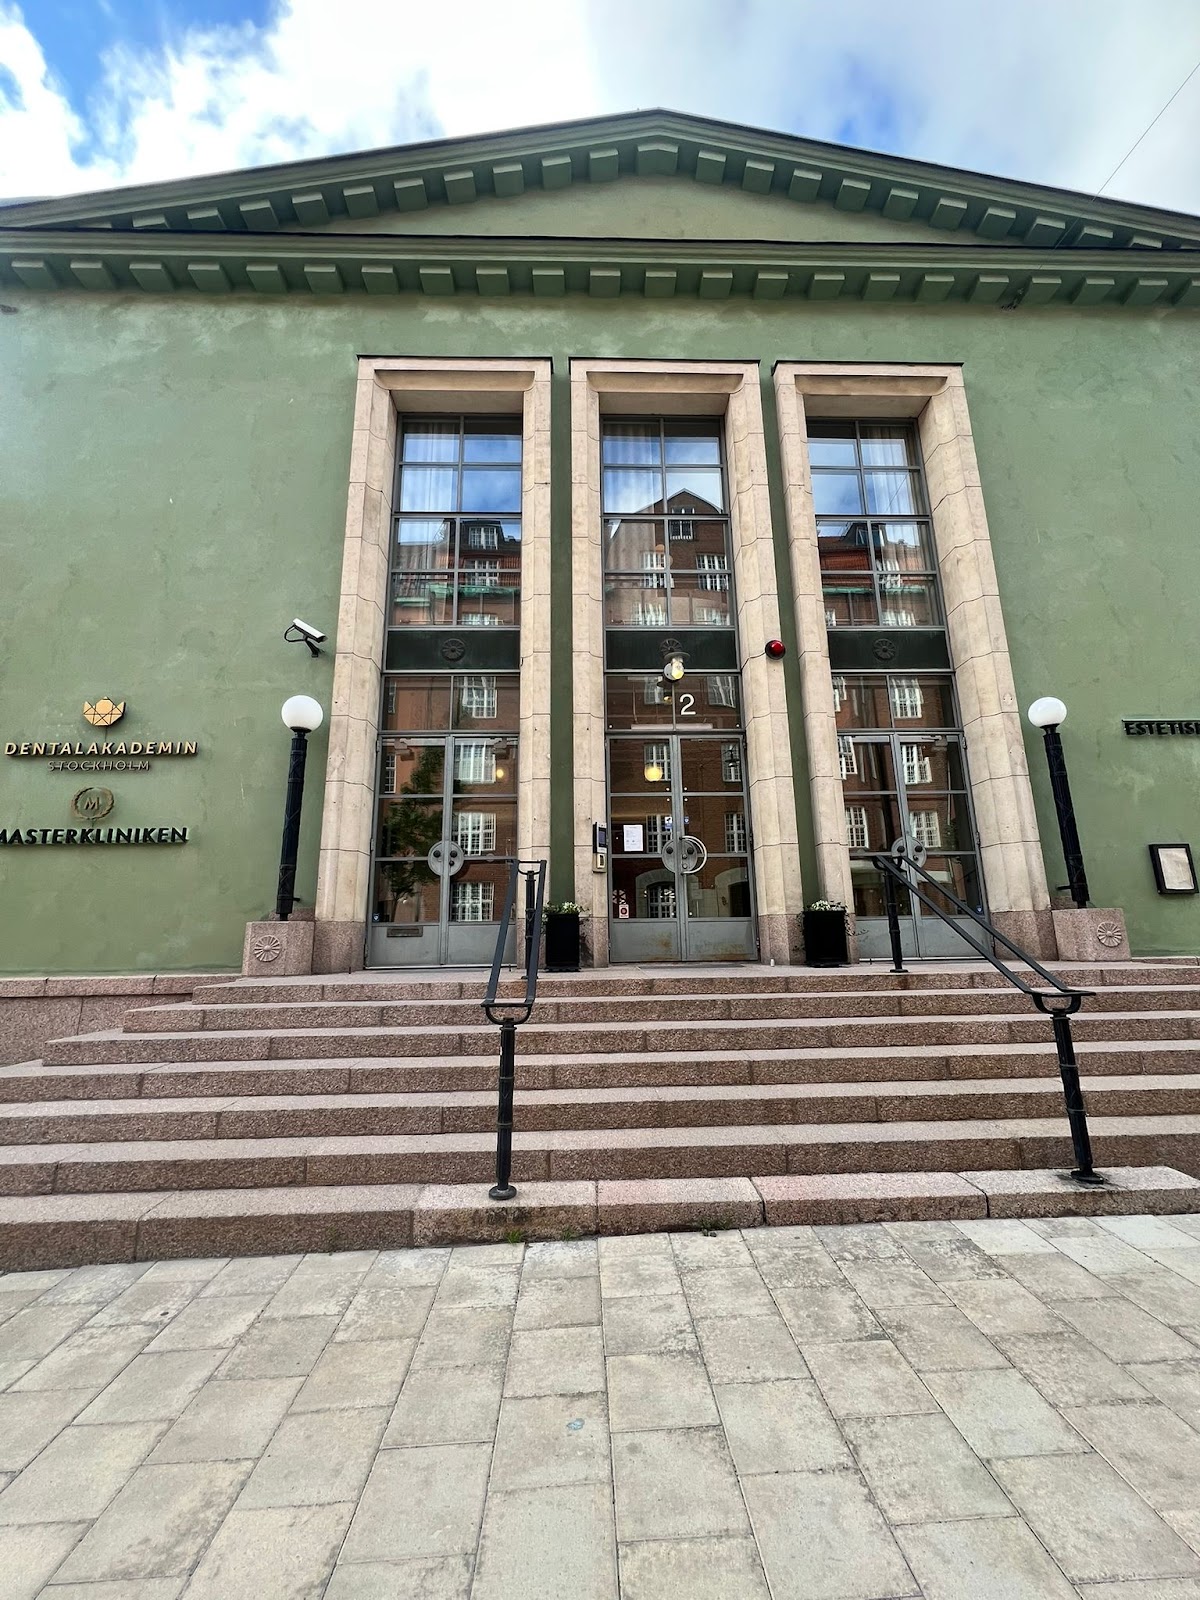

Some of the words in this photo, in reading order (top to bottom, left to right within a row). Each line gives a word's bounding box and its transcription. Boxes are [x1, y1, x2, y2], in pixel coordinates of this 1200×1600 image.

[679, 693, 697, 716] 2
[4, 741, 198, 756] DENTALAKADEMIN
[47, 760, 151, 772] STOCKHOLM
